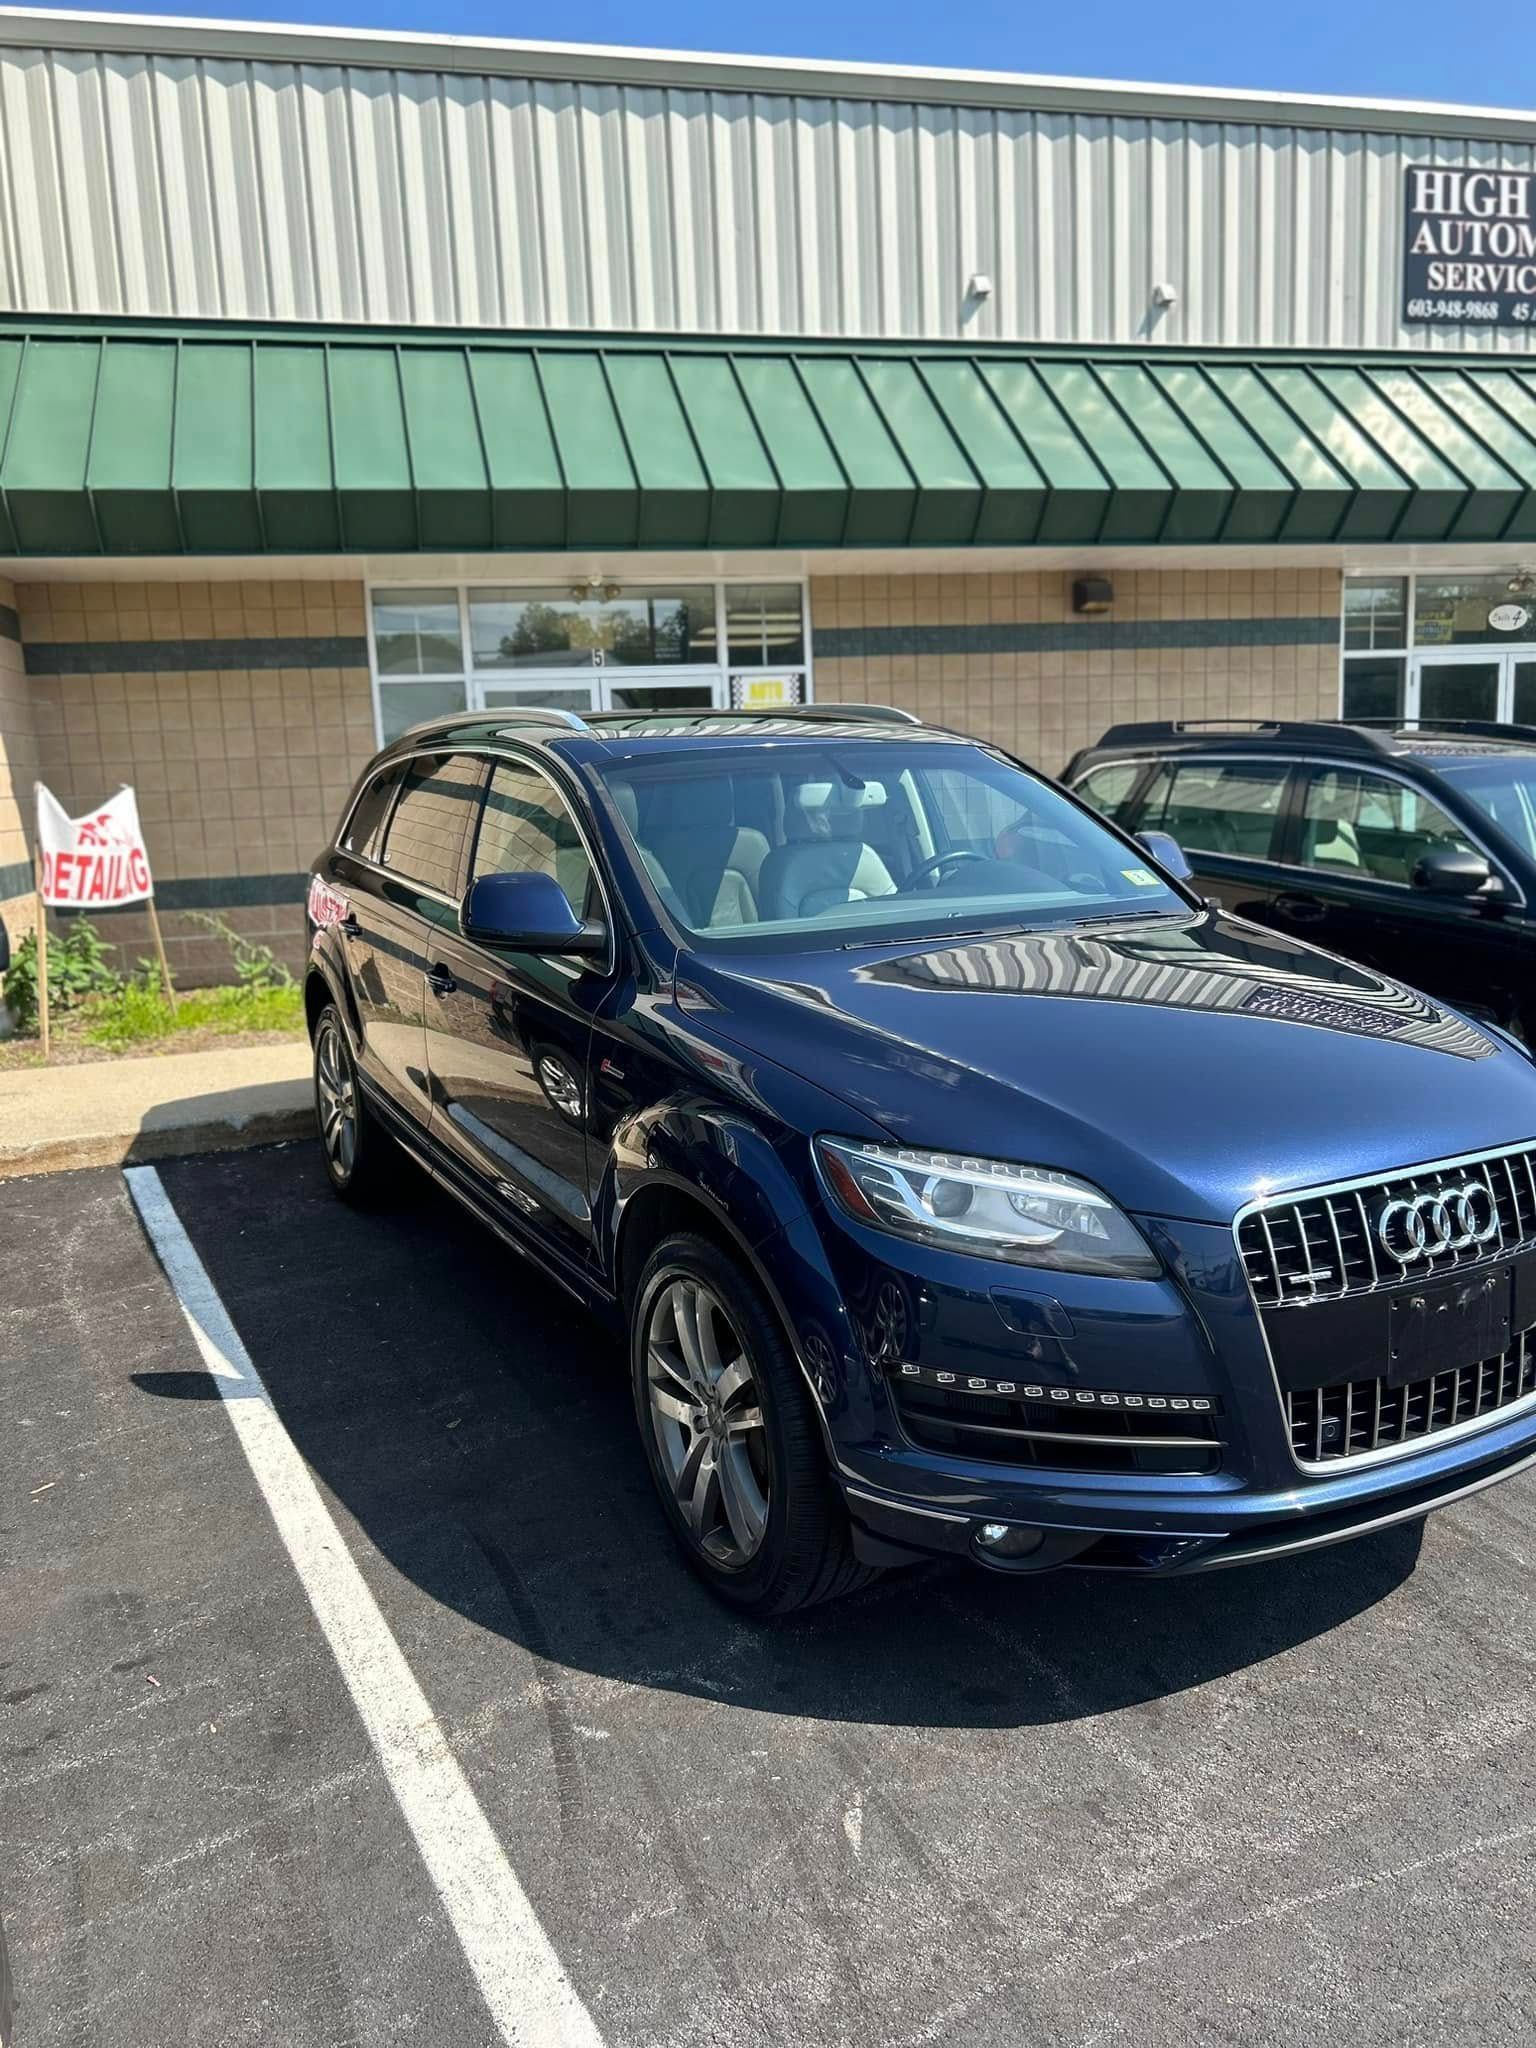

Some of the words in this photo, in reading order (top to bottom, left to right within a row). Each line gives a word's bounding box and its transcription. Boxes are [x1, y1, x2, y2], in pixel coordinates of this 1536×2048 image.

[1411, 170, 1531, 218] HIGH
[1427, 261, 1536, 294] SERVIC
[1407, 299, 1499, 319] 603-948-9868
[1511, 303, 1530, 321] 45
